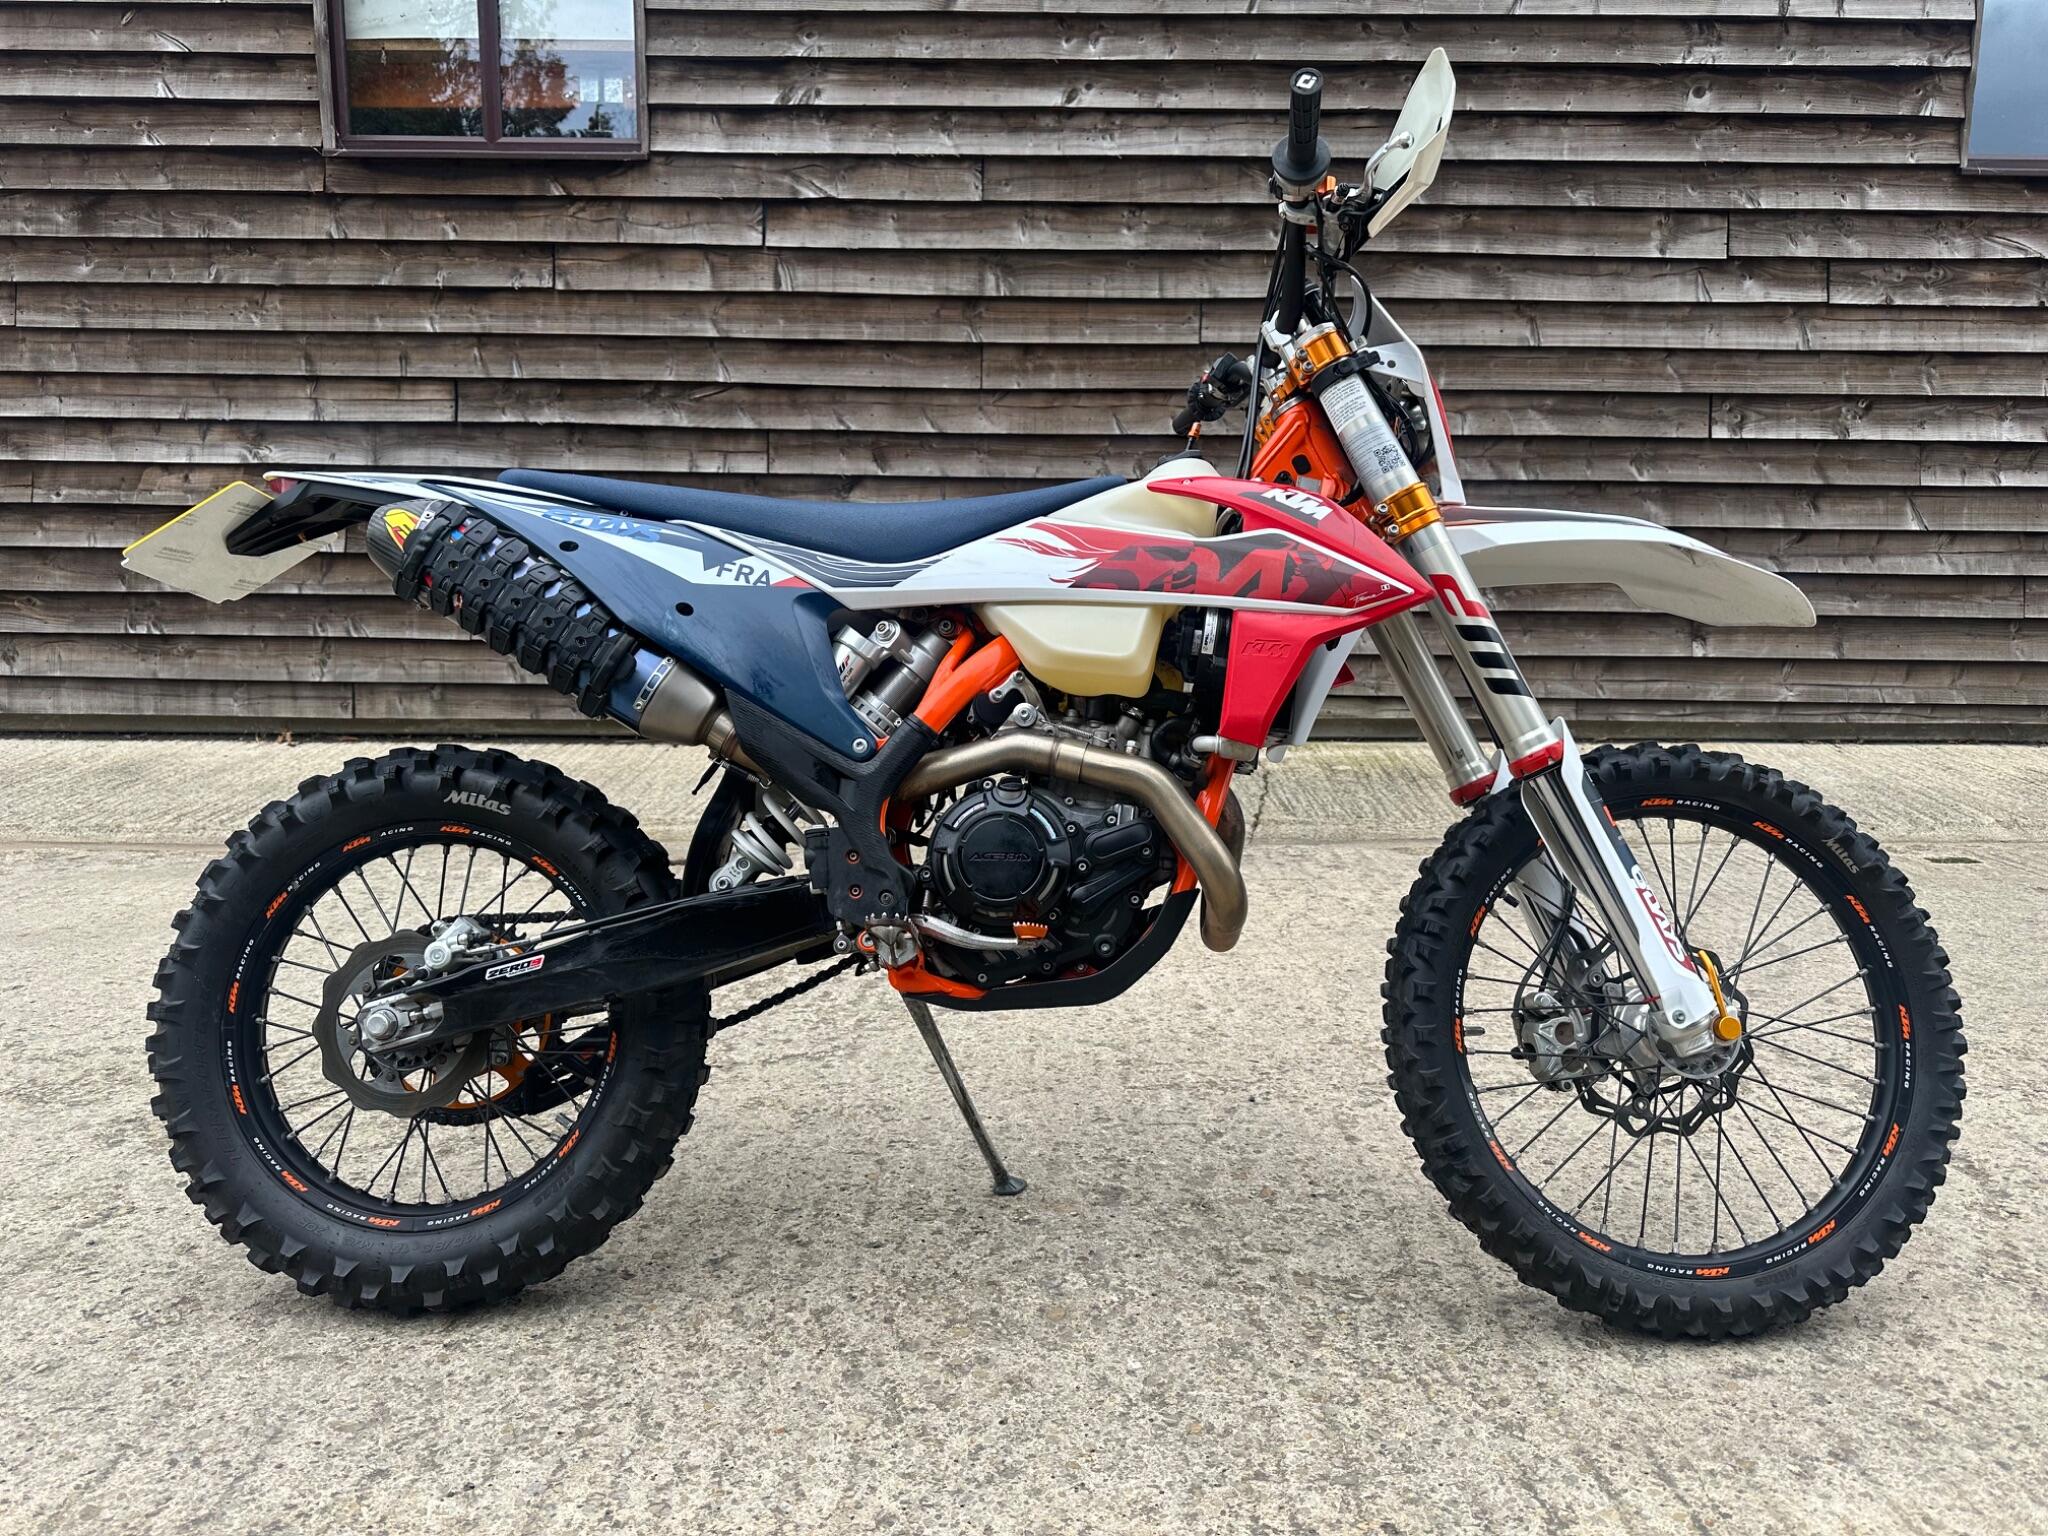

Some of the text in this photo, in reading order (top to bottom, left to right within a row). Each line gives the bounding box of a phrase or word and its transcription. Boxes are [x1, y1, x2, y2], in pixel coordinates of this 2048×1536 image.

[1260, 487, 1335, 521] KTM
[715, 562, 771, 587] FRA
[1240, 639, 1292, 658] KTM
[443, 790, 512, 816] Mitas
[1641, 797, 1721, 811] KTM RACING
[342, 836, 371, 852] KTM
[440, 824, 513, 846] KTM RACING
[1751, 820, 1824, 869] KTM RACING
[531, 855, 588, 907] KTM RACING
[1469, 867, 1512, 938] KTM RACING
[265, 891, 289, 920] KTM
[1846, 894, 1893, 968] KTM RACING
[228, 938, 254, 1014] KTM RACING
[1453, 968, 1464, 1056] KTM RACING
[1897, 1003, 1911, 1090] KTM RACING
[227, 1040, 248, 1115] KTM RACING
[253, 1137, 309, 1193] KTM RACING
[523, 1128, 581, 1190] KTM RACING
[1489, 1140, 1514, 1172] KTM
[1859, 1122, 1900, 1198] KTM RACING
[326, 1203, 401, 1228] KTM RACING
[427, 1199, 502, 1226] KTM RACING
[1537, 1200, 1613, 1253] KTM RACING
[1765, 1219, 1837, 1264] KTM RACING
[1647, 1263, 1732, 1278] KTM RACING
